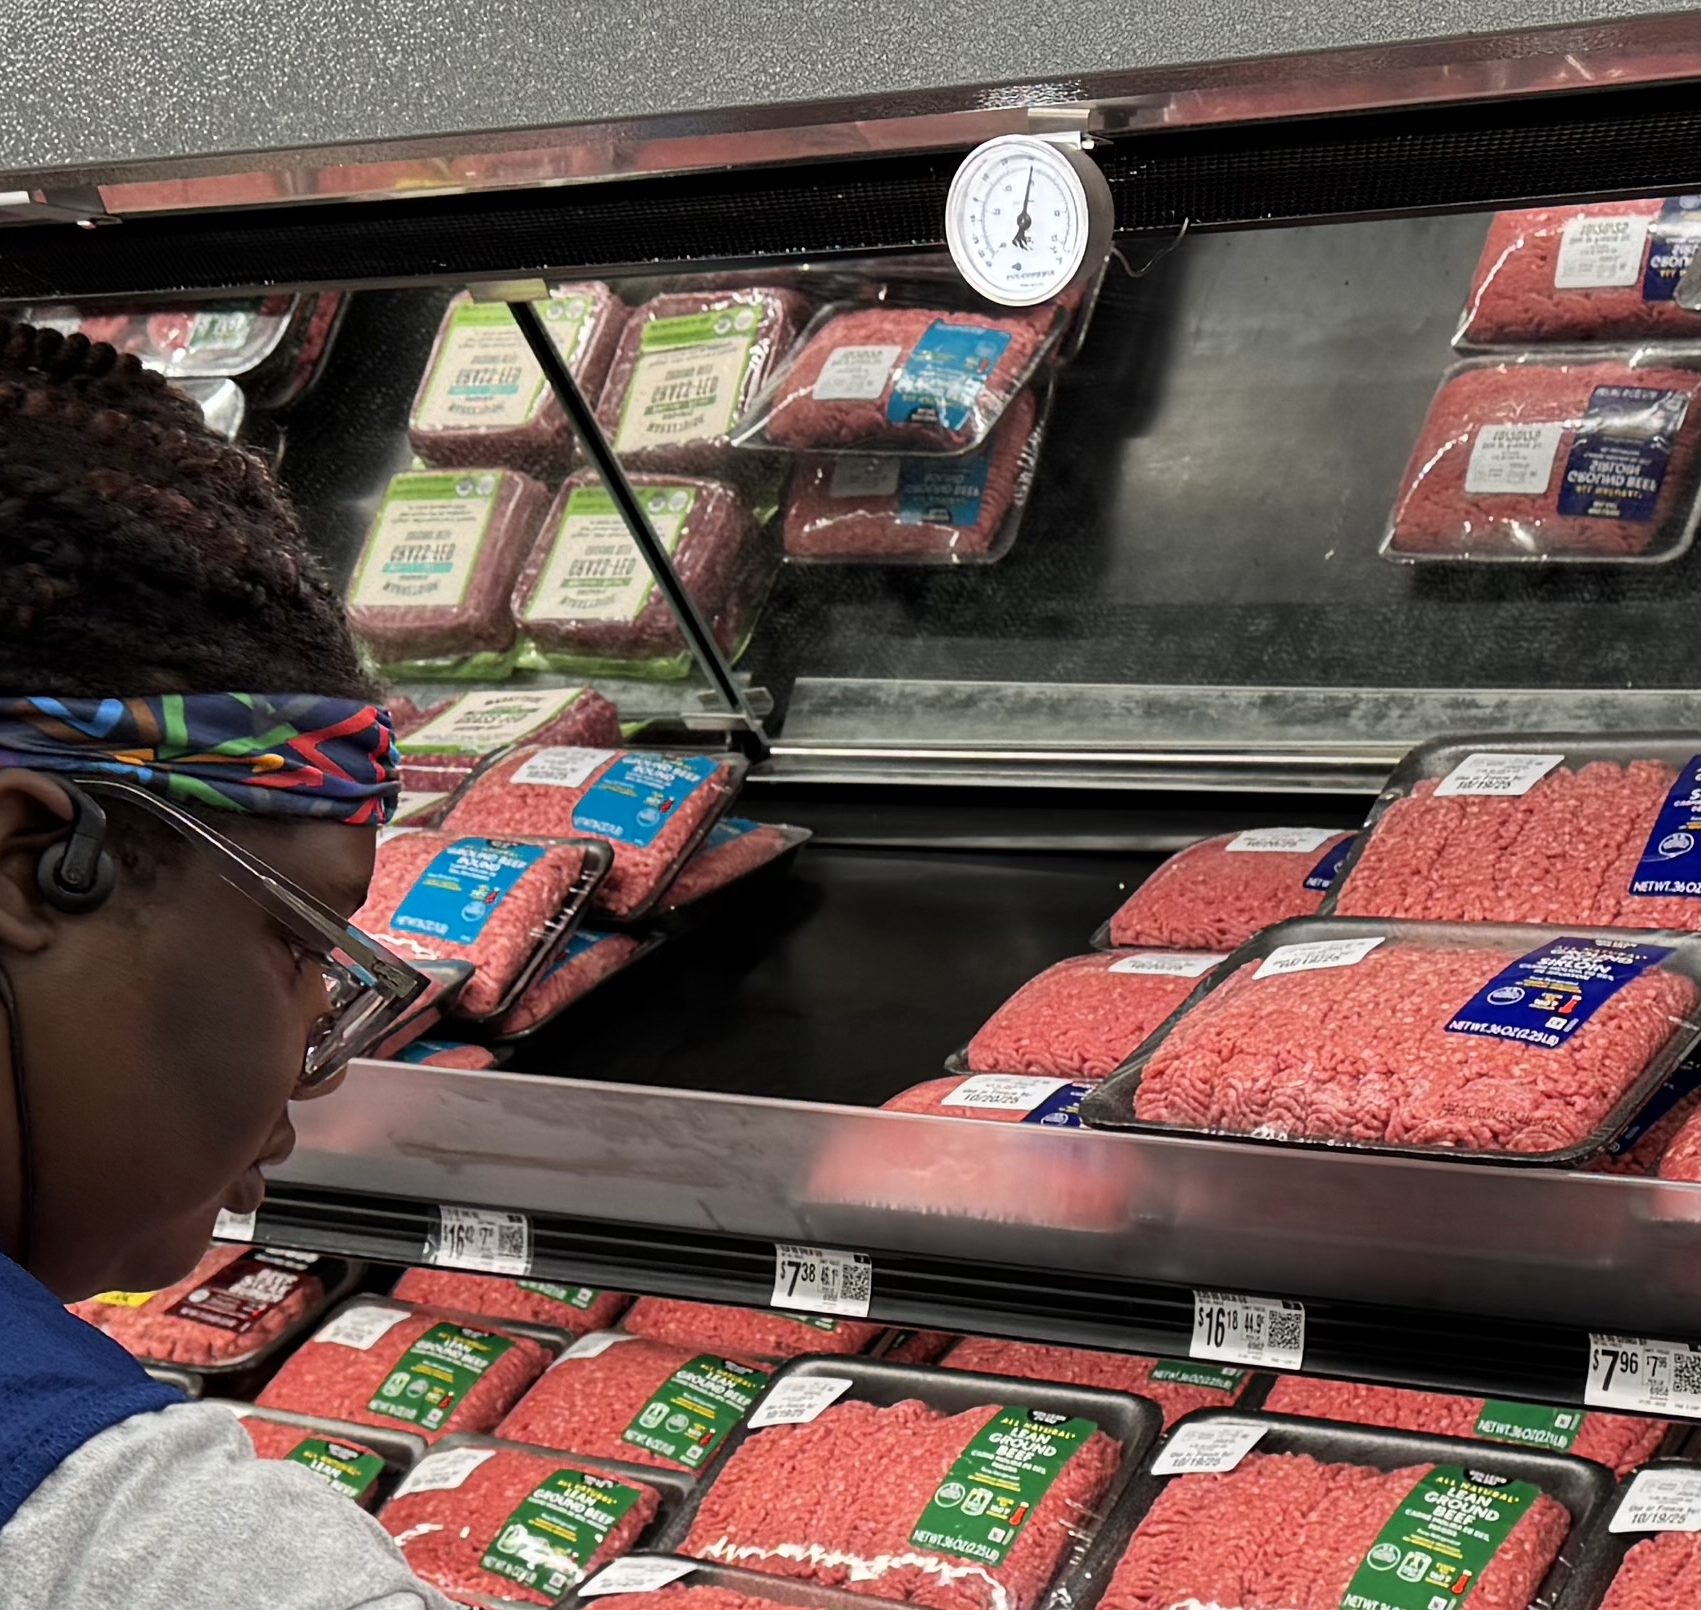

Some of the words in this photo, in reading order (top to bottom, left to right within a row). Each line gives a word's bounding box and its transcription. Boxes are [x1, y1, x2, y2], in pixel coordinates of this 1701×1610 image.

[1536, 956, 1612, 973] SIRLOIN
[1010, 1427, 1052, 1444] LEAN
[989, 1433, 1057, 1457] GROUND
[996, 1445, 1035, 1461] BEEF
[1630, 1511, 1687, 1526] 10/19/25
